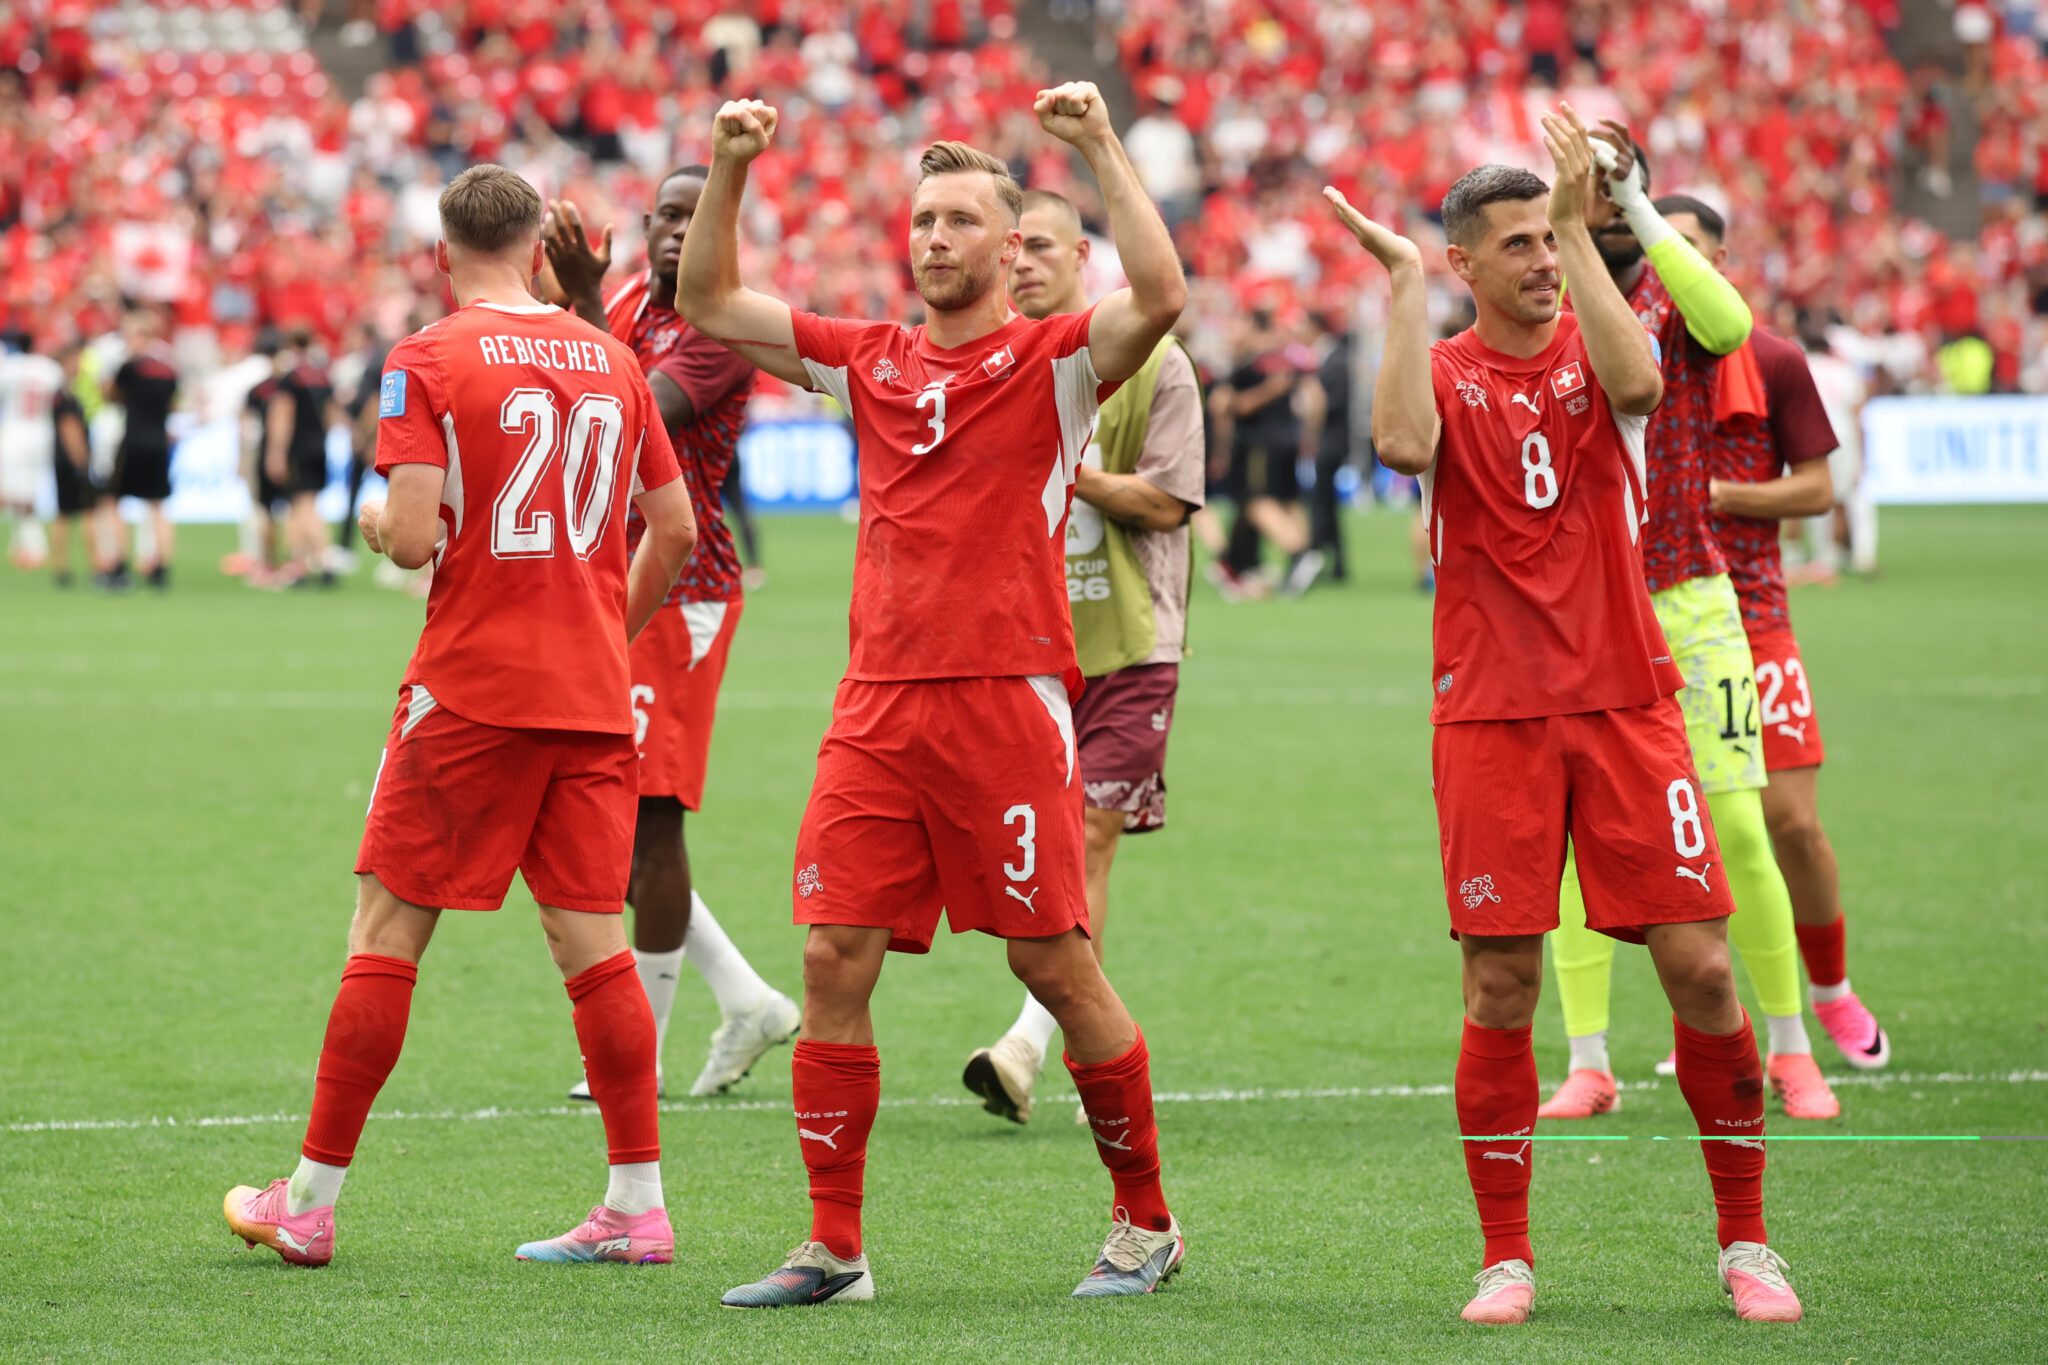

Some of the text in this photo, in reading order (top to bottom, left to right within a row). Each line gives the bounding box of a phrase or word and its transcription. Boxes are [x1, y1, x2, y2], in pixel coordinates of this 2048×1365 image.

[479, 335, 611, 374] AEBISCHER
[911, 388, 946, 455] 3
[491, 387, 624, 562] 20
[1521, 431, 1559, 510] 8
[1074, 560, 1108, 575] CUP
[1718, 677, 1757, 740] 12
[1755, 657, 1813, 726] 23
[1003, 803, 1037, 882] 3
[1666, 777, 1707, 859] 8
